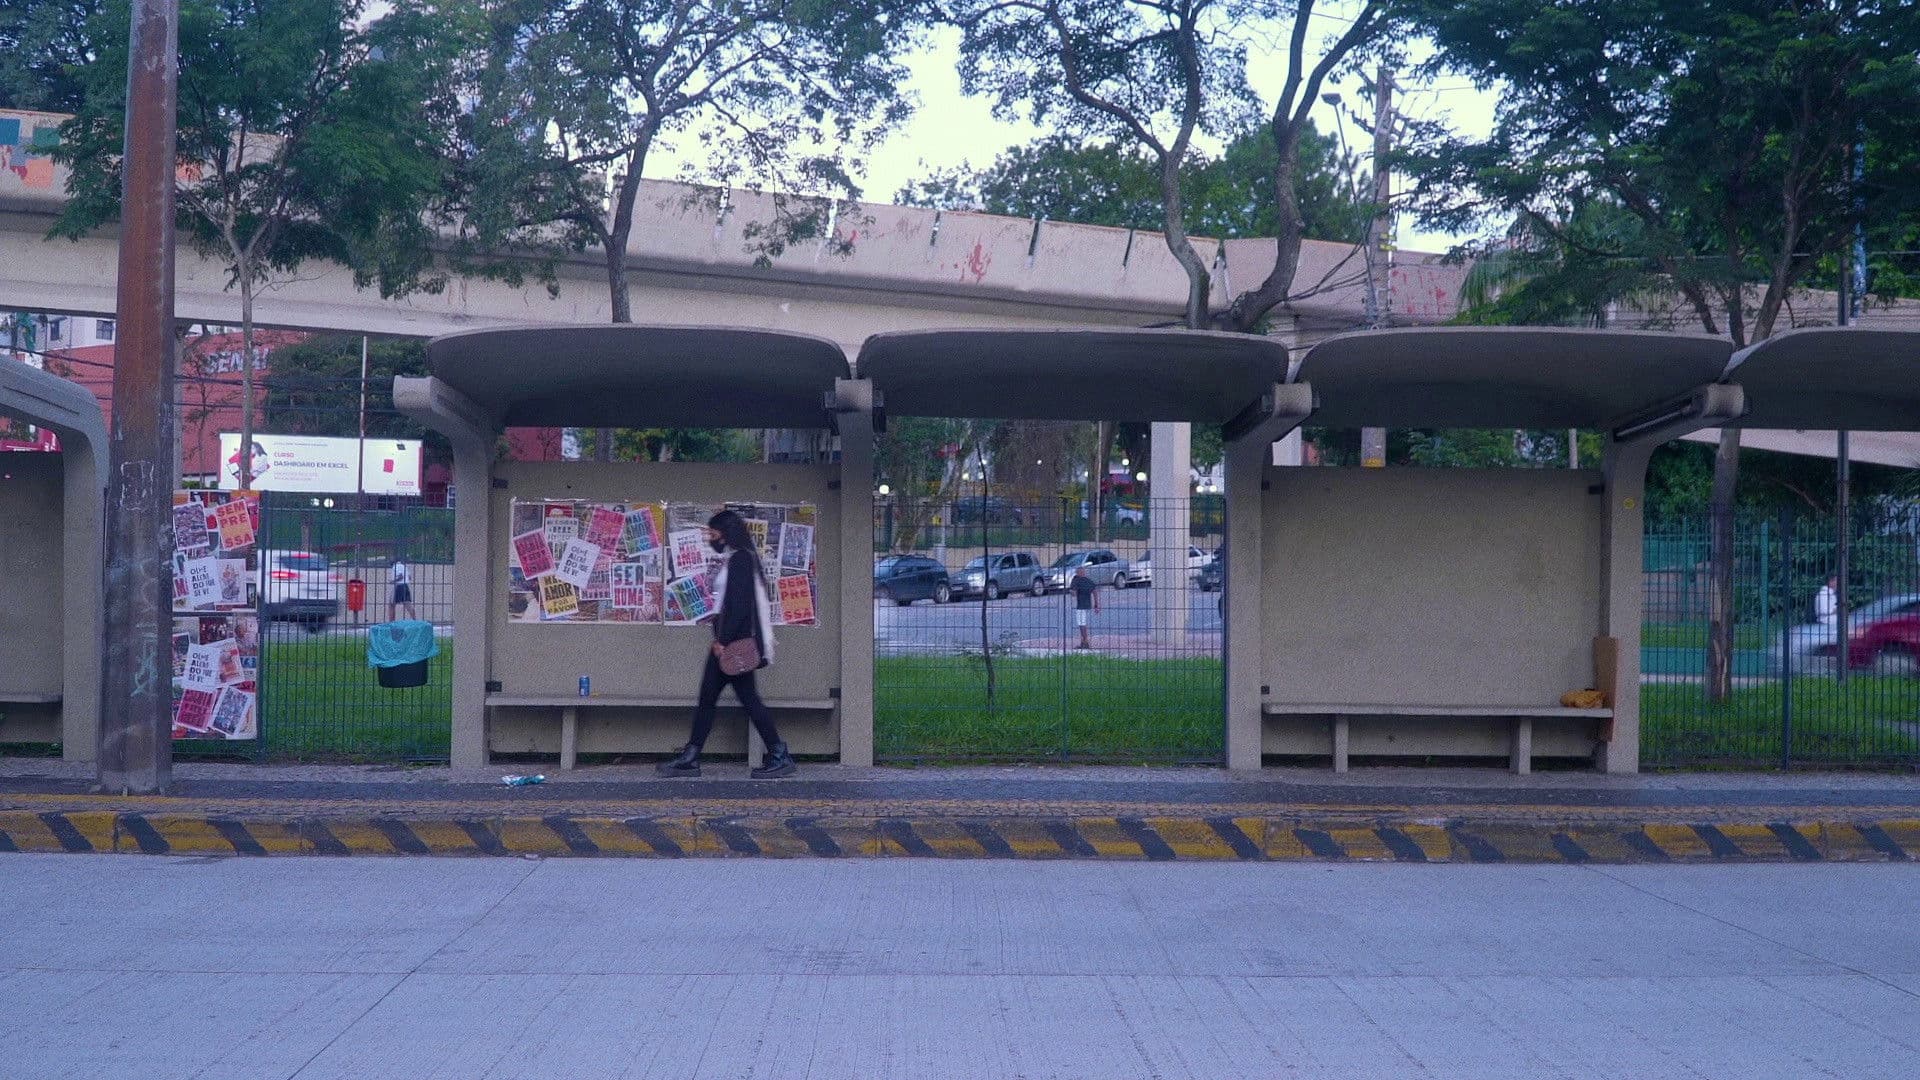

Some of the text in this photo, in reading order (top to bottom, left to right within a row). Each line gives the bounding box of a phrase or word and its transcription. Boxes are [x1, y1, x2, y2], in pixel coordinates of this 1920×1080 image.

[216, 501, 245, 517] SEM
[220, 514, 247, 528] PRE
[225, 533, 252, 548] SSA
[566, 560, 578, 568] DO
[614, 565, 644, 586] SER
[192, 581, 204, 590] DO
[778, 577, 807, 589] SEM
[544, 582, 572, 601] AMOR
[780, 589, 808, 601] PRE
[784, 609, 812, 620] SSA
[189, 666, 202, 674] DO
